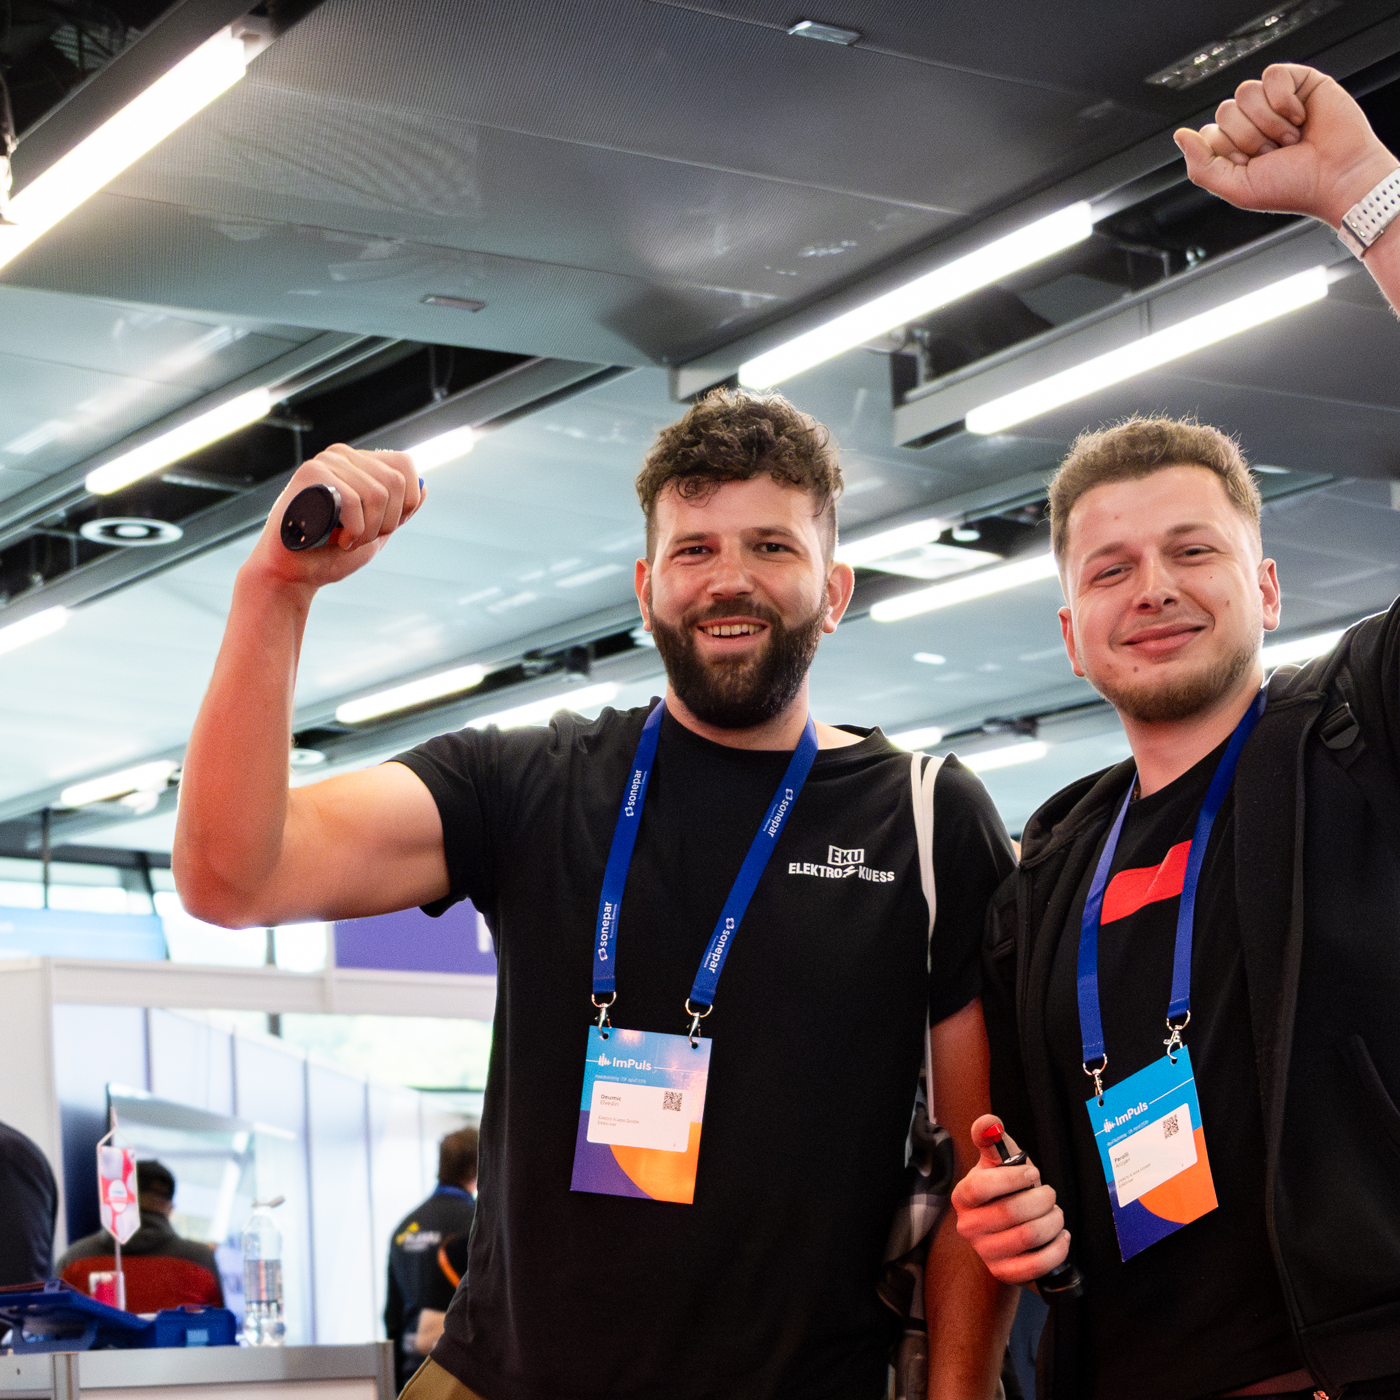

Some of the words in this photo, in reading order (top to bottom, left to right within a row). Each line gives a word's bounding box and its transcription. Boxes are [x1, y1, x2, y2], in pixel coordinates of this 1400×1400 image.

[627, 769, 643, 807] sonepar
[768, 799, 789, 838] sonepar
[830, 847, 862, 864] EKU
[788, 862, 843, 879] ELEKTRO
[857, 865, 895, 883] KUESS
[600, 901, 613, 947] sonepar
[708, 929, 731, 974] sonepar
[612, 1057, 652, 1071] ImPuls
[1114, 1102, 1149, 1126] ImPuls
